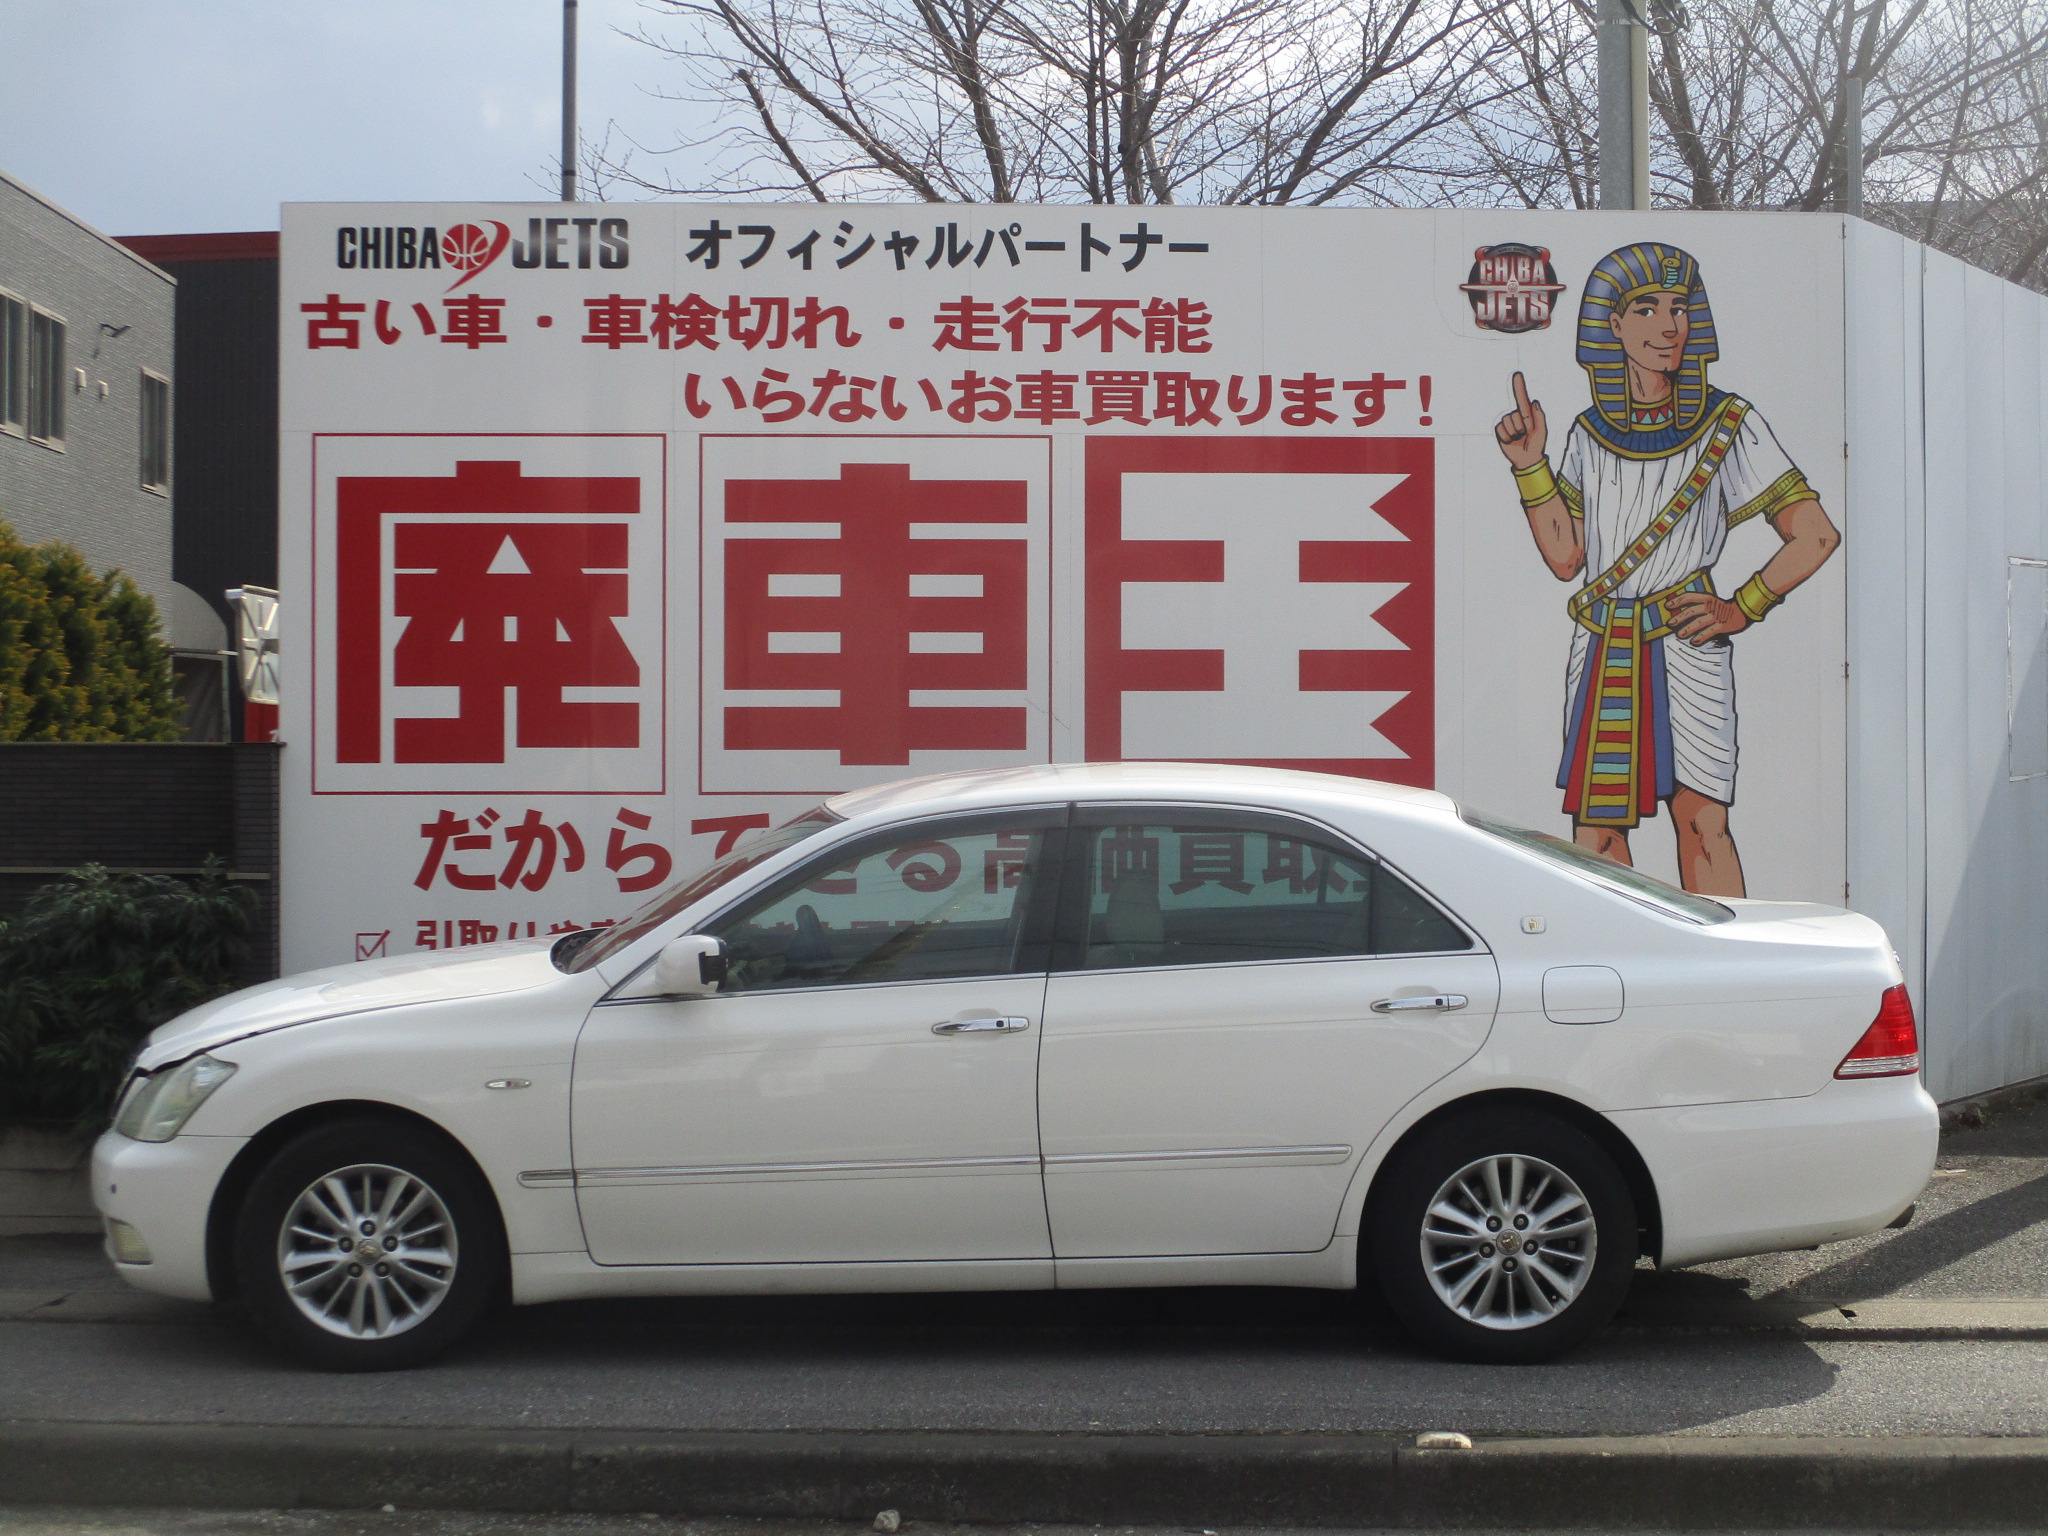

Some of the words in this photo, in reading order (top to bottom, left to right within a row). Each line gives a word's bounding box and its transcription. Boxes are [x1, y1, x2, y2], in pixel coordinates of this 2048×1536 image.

[337, 226, 441, 270] CHIBA
[512, 218, 629, 270] JETS
[686, 220, 1210, 273] オフィシャルパートナー
[1480, 254, 1546, 284] CHIBA
[301, 294, 1213, 354] 古い車・車検切れ・走行不能
[1477, 290, 1549, 323] JETS
[685, 368, 1433, 427] いらないお車買取ります!
[336, 460, 1424, 766] 廃車王
